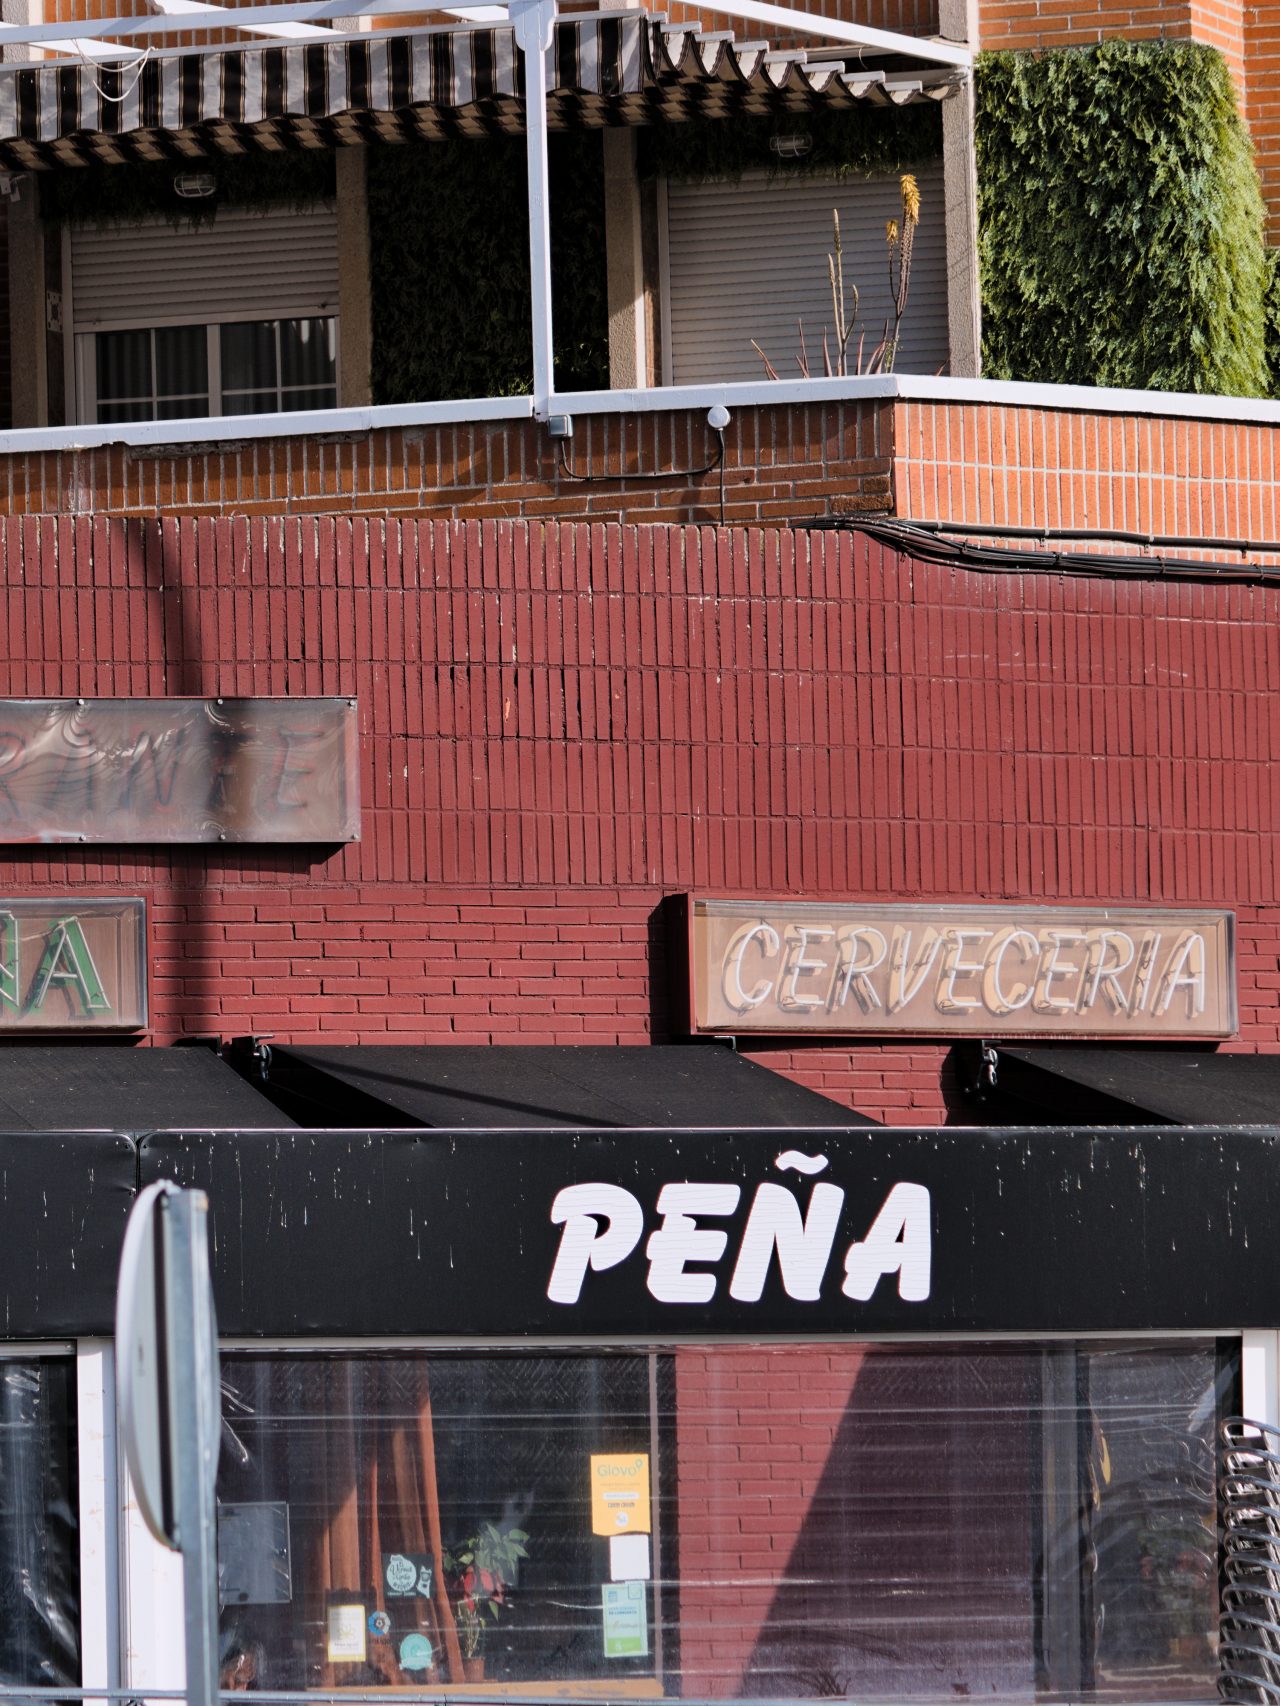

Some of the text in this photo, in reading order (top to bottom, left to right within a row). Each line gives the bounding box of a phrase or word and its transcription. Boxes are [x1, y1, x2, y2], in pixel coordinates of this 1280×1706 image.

[723, 921, 1206, 1018] CERVECERIA
[546, 1150, 932, 1304] PEÑA
[597, 1460, 642, 1477] Glovo
